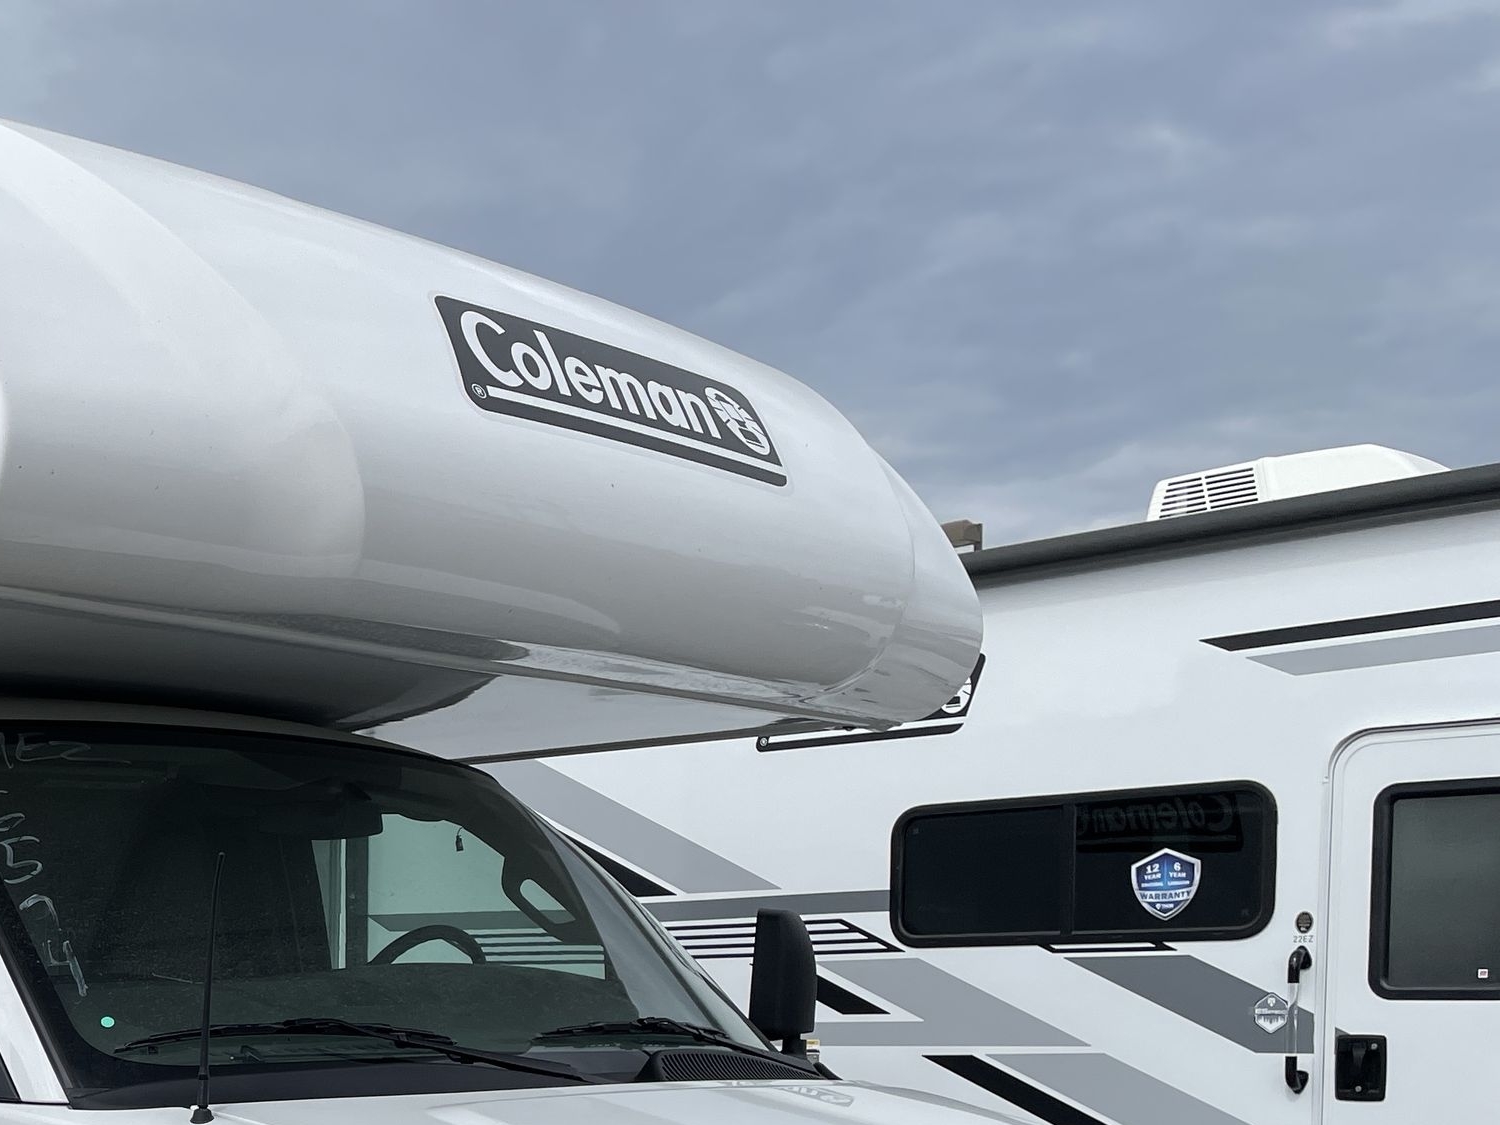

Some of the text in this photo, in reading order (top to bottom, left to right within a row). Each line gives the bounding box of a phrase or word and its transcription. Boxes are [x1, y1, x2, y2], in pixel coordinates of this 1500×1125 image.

[460, 310, 722, 440] Coleman
[1145, 863, 1160, 874] 12
[1173, 861, 1182, 872] 6
[1140, 890, 1192, 900] WARRANTY
